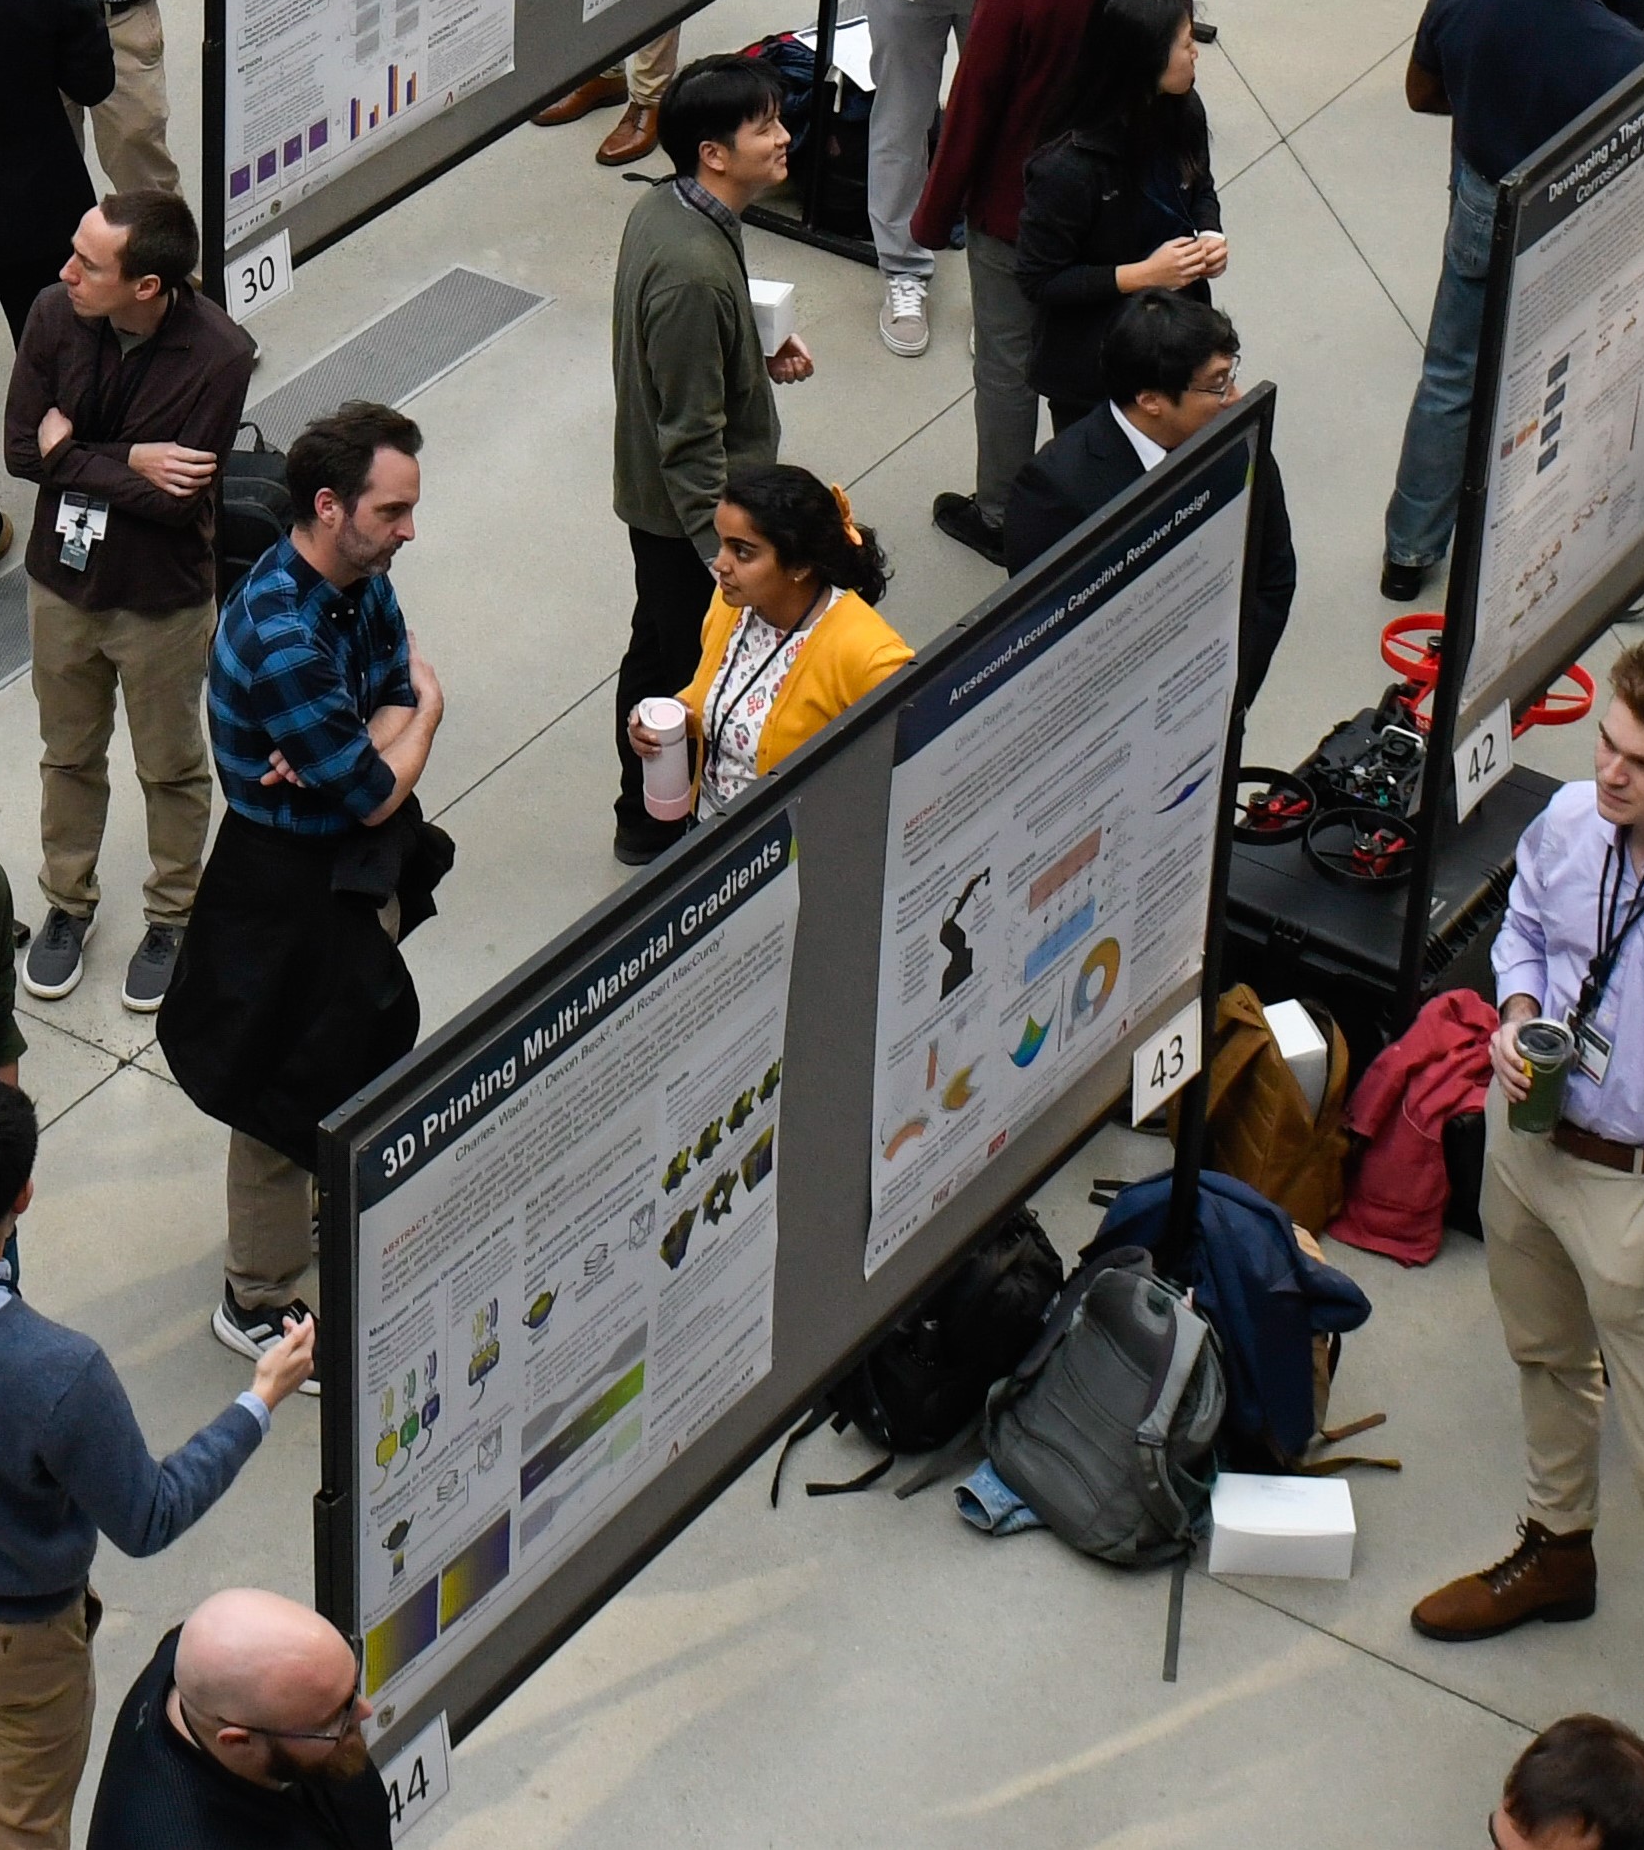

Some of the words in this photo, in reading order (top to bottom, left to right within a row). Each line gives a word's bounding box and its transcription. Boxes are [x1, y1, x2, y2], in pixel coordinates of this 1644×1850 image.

[1549, 138, 1608, 206] Developing
[1610, 137, 1616, 153] a
[1576, 148, 1628, 206] Corrosion
[1630, 136, 1642, 160] of
[242, 256, 274, 303] 30
[949, 599, 1065, 708] Arcsecond-Accurate
[1067, 554, 1123, 616] Capacitive
[1126, 516, 1171, 566] Resolver
[1174, 484, 1209, 529] Design
[1468, 732, 1496, 784] 42
[381, 1125, 416, 1184] 3D
[423, 1046, 516, 1155] Printing
[524, 919, 672, 1068] Multi-Material
[680, 831, 780, 939] Gradients
[455, 1118, 495, 1164] Charles
[545, 1050, 578, 1090] Devon
[615, 1004, 634, 1032] and
[637, 975, 669, 1014] Robert
[1150, 1034, 1184, 1090] 43
